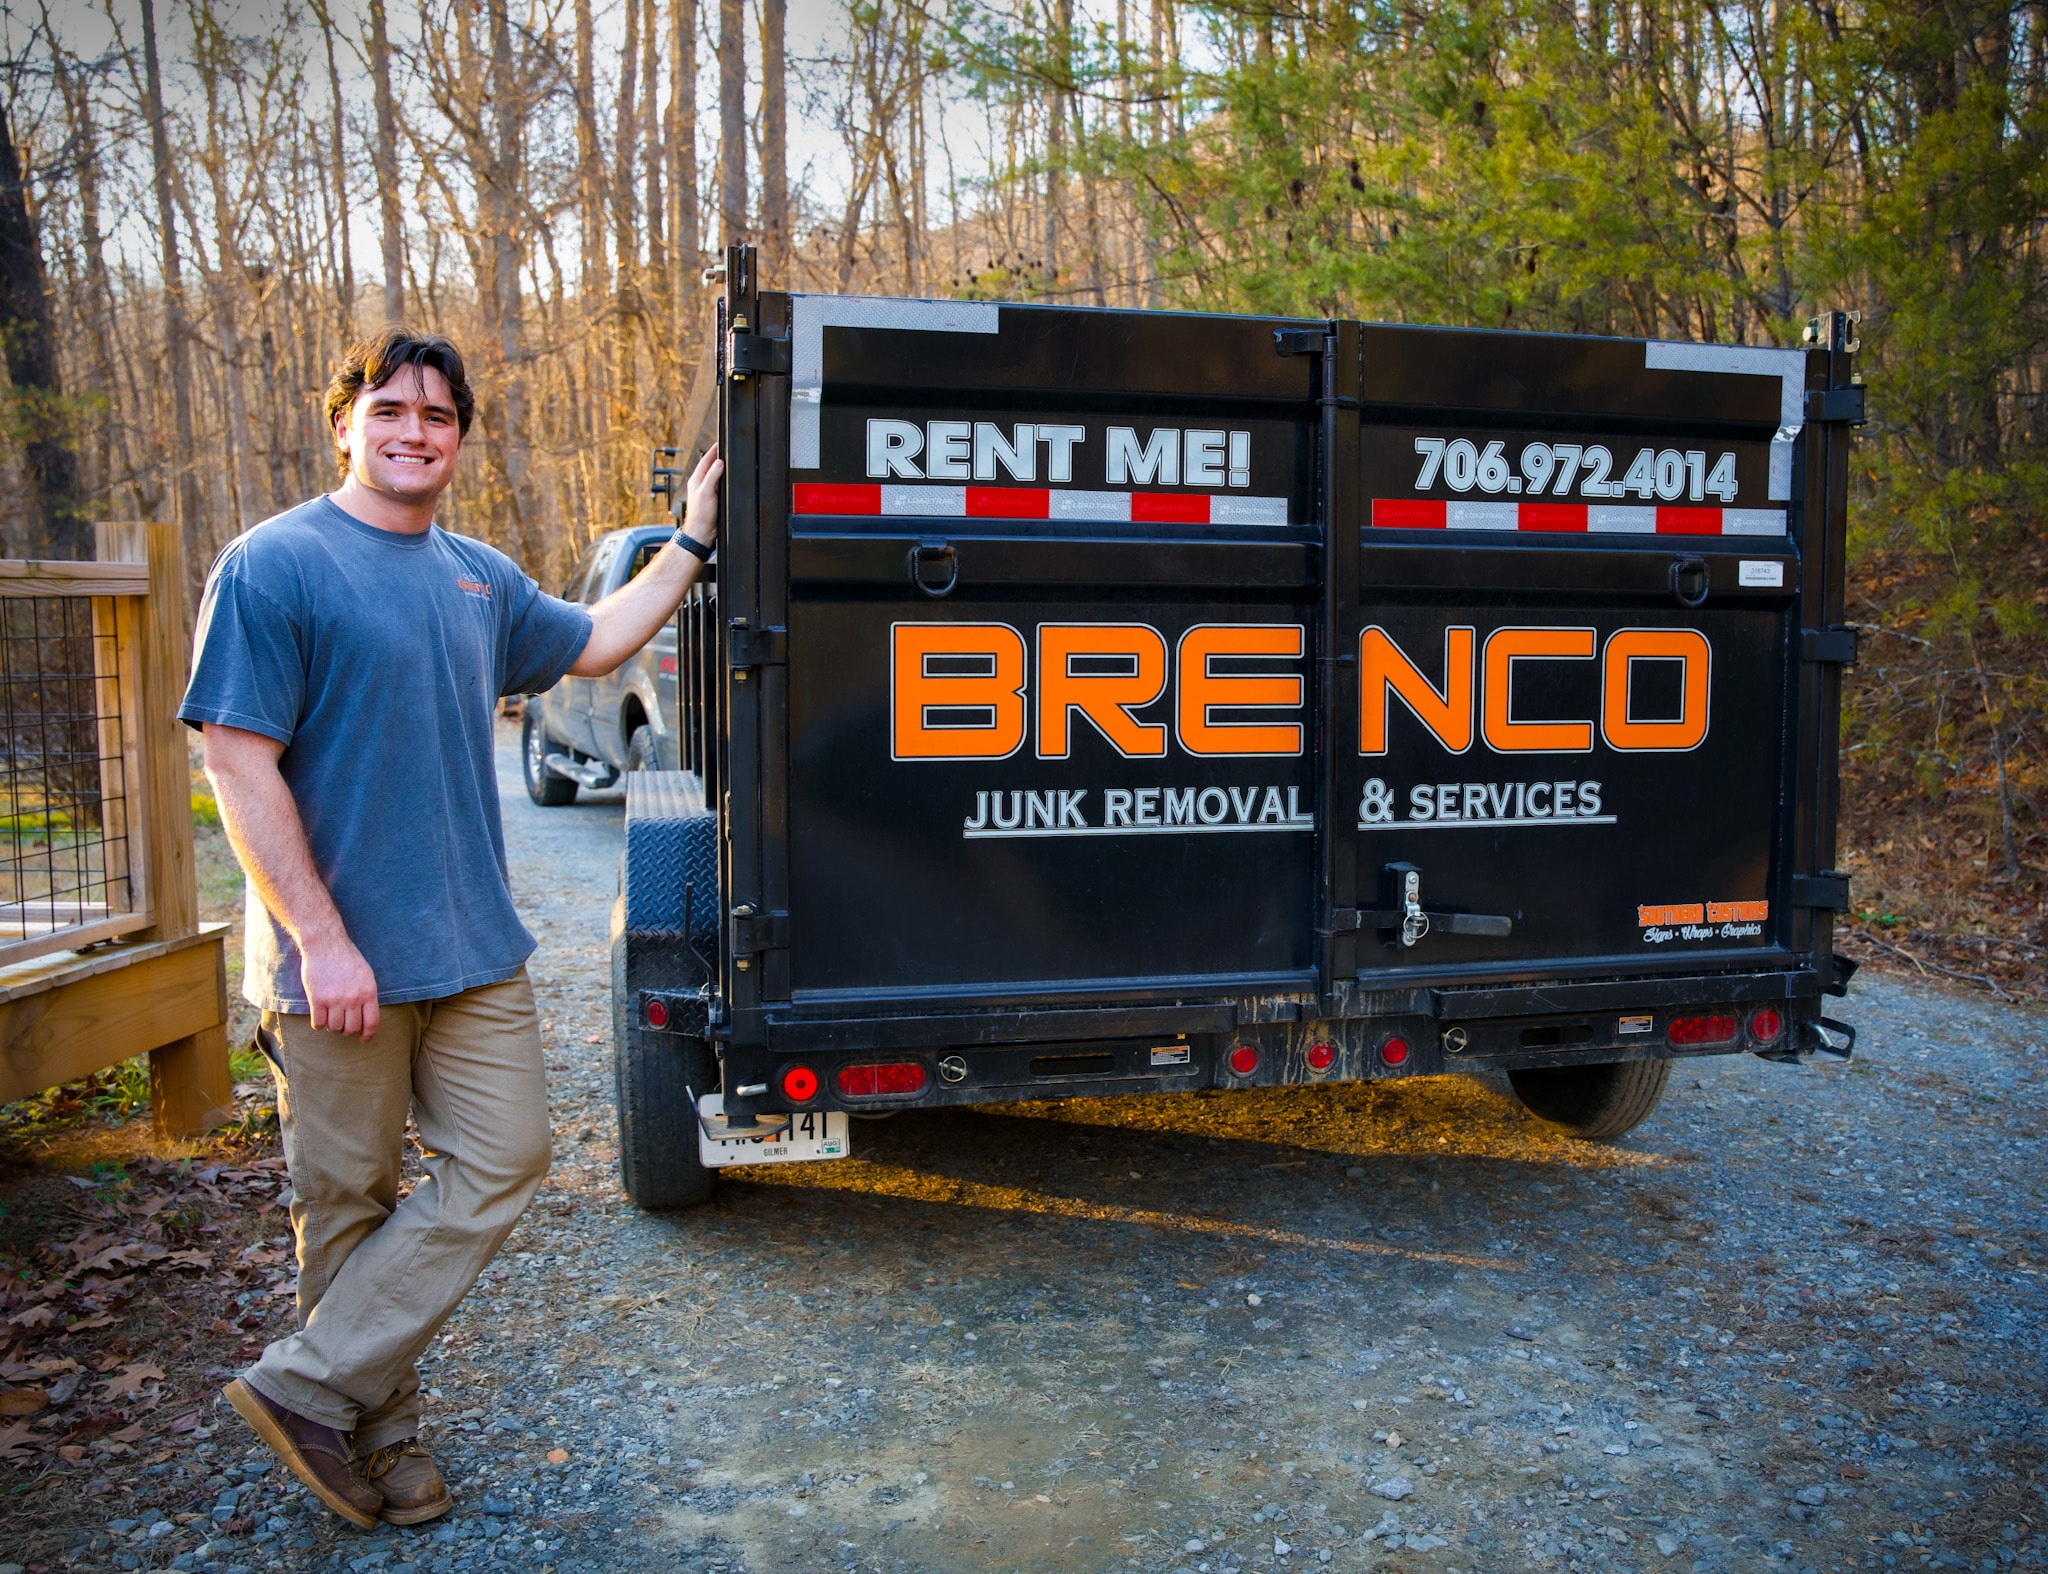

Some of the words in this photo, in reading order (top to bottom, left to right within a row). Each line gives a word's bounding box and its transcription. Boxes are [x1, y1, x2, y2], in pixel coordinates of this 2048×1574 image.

[866, 418, 1086, 482] RENT
[1105, 425, 1251, 488] ME!
[1413, 437, 1739, 502] 706.972.4014
[890, 621, 1712, 761] BRENCO
[964, 790, 1088, 829] JUNK
[1103, 786, 1315, 826] REMOVAL
[1359, 777, 1394, 823] &
[1408, 780, 1602, 821] SERVICES
[1637, 904, 1704, 927] SOUTHERN
[1705, 900, 1769, 923] CUSTOMS
[1643, 927, 1673, 943] Signs
[1681, 925, 1713, 941] Wraps
[1721, 923, 1761, 939] Graphics
[763, 1147, 788, 1157] GILMER
